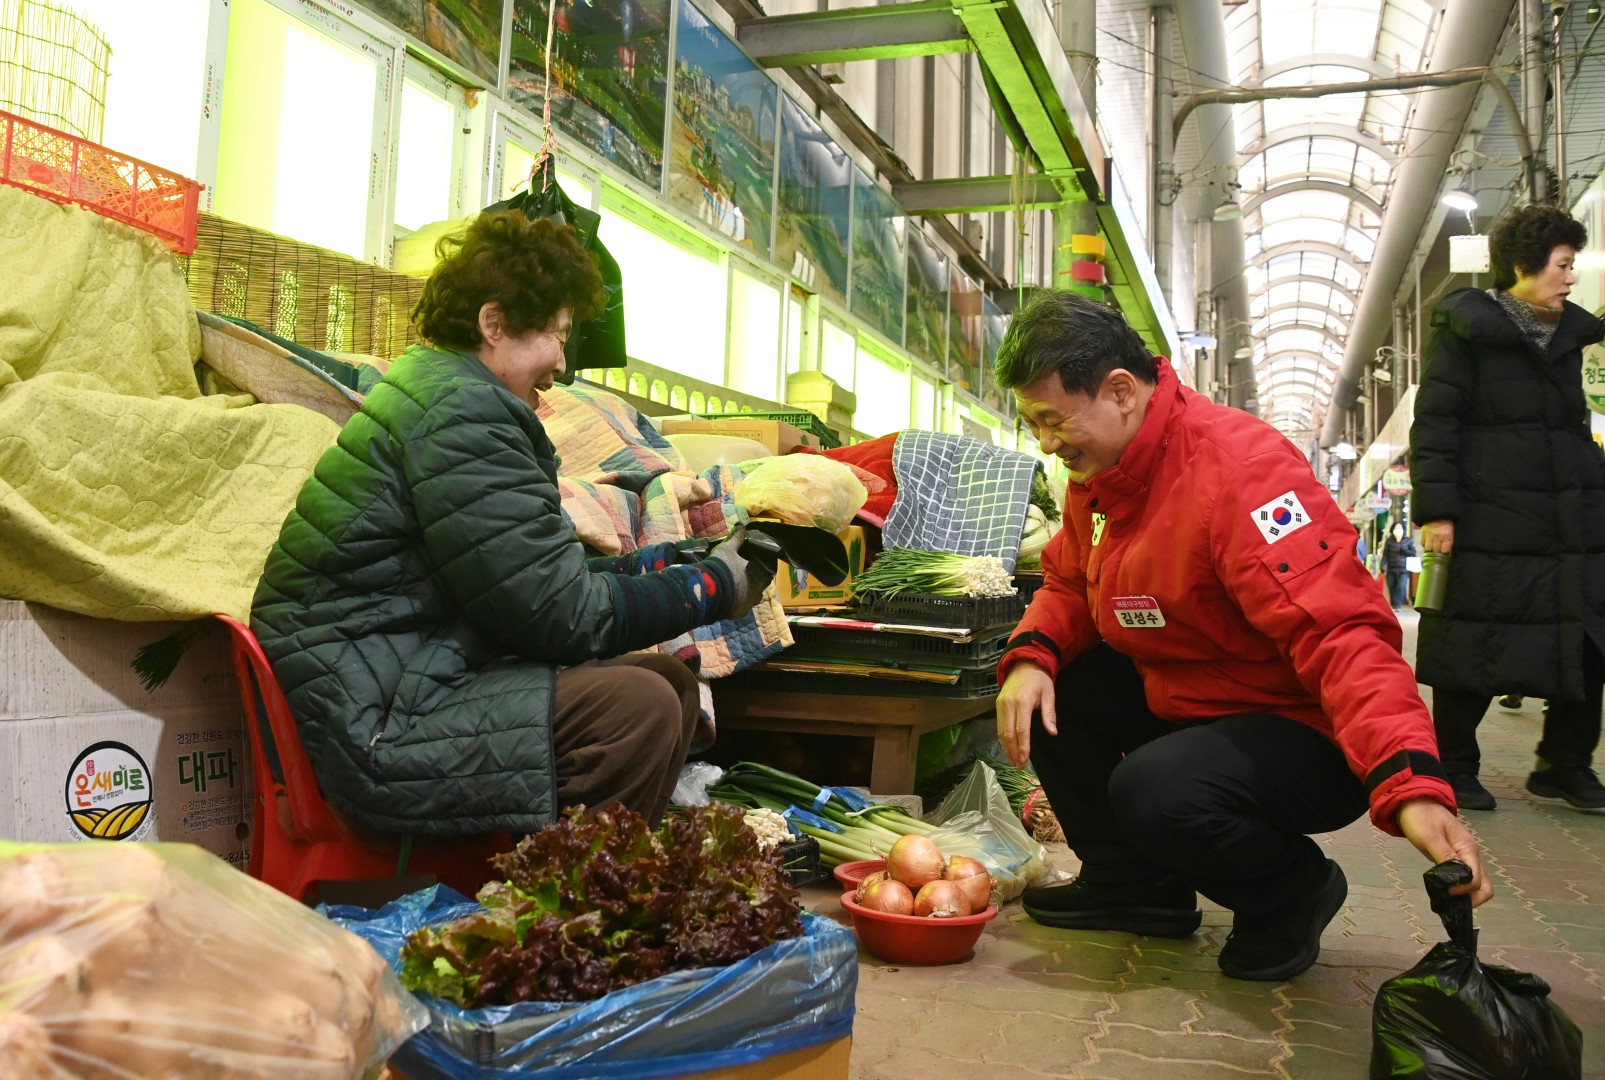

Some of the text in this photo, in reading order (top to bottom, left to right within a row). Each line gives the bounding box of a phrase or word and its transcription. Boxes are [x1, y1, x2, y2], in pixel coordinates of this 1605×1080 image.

[1120, 611, 1159, 625] 김성수
[177, 732, 200, 745] 건강한
[201, 730, 225, 743] 강원도
[178, 747, 238, 793] 대파
[75, 768, 145, 807] 온새미로
